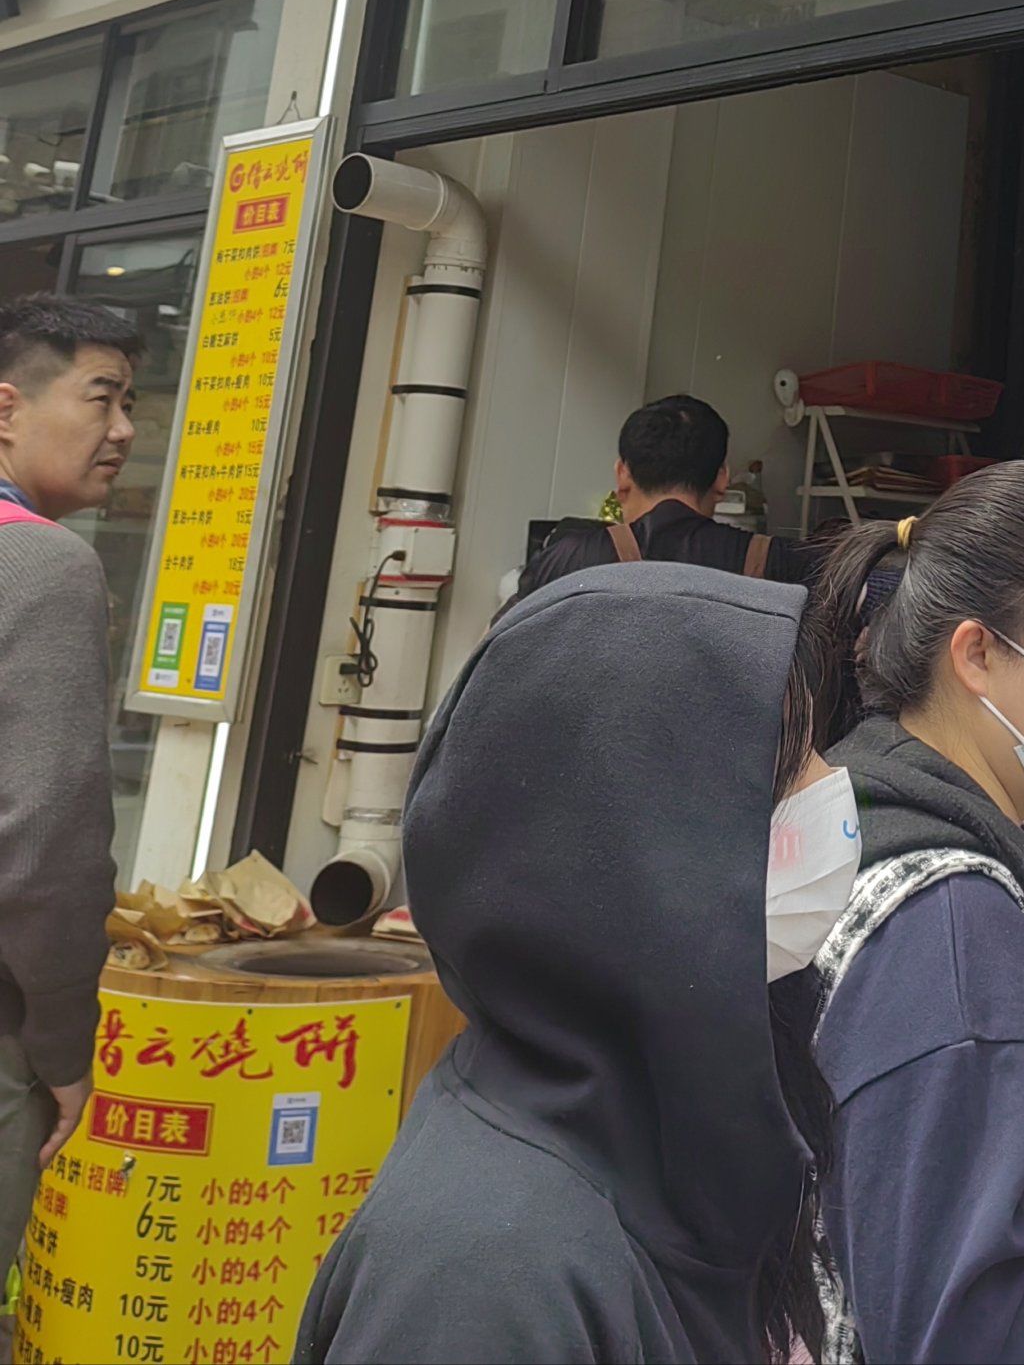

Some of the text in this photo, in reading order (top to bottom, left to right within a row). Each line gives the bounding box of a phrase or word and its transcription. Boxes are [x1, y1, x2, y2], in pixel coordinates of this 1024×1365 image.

[242, 202, 281, 226] 价目表
[106, 1103, 191, 1144] 价目表
[147, 1175, 181, 1202] 7元
[201, 1176, 296, 1206] 小的4个
[321, 1168, 375, 1197] 12元
[197, 1216, 291, 1245] 小的4个
[317, 1209, 360, 1236] 12
[136, 1255, 172, 1283] 5元
[192, 1255, 288, 1285] 小的4个
[120, 1293, 168, 1323] 10元
[188, 1295, 284, 1325] 小的4个
[116, 1334, 164, 1363] 10元
